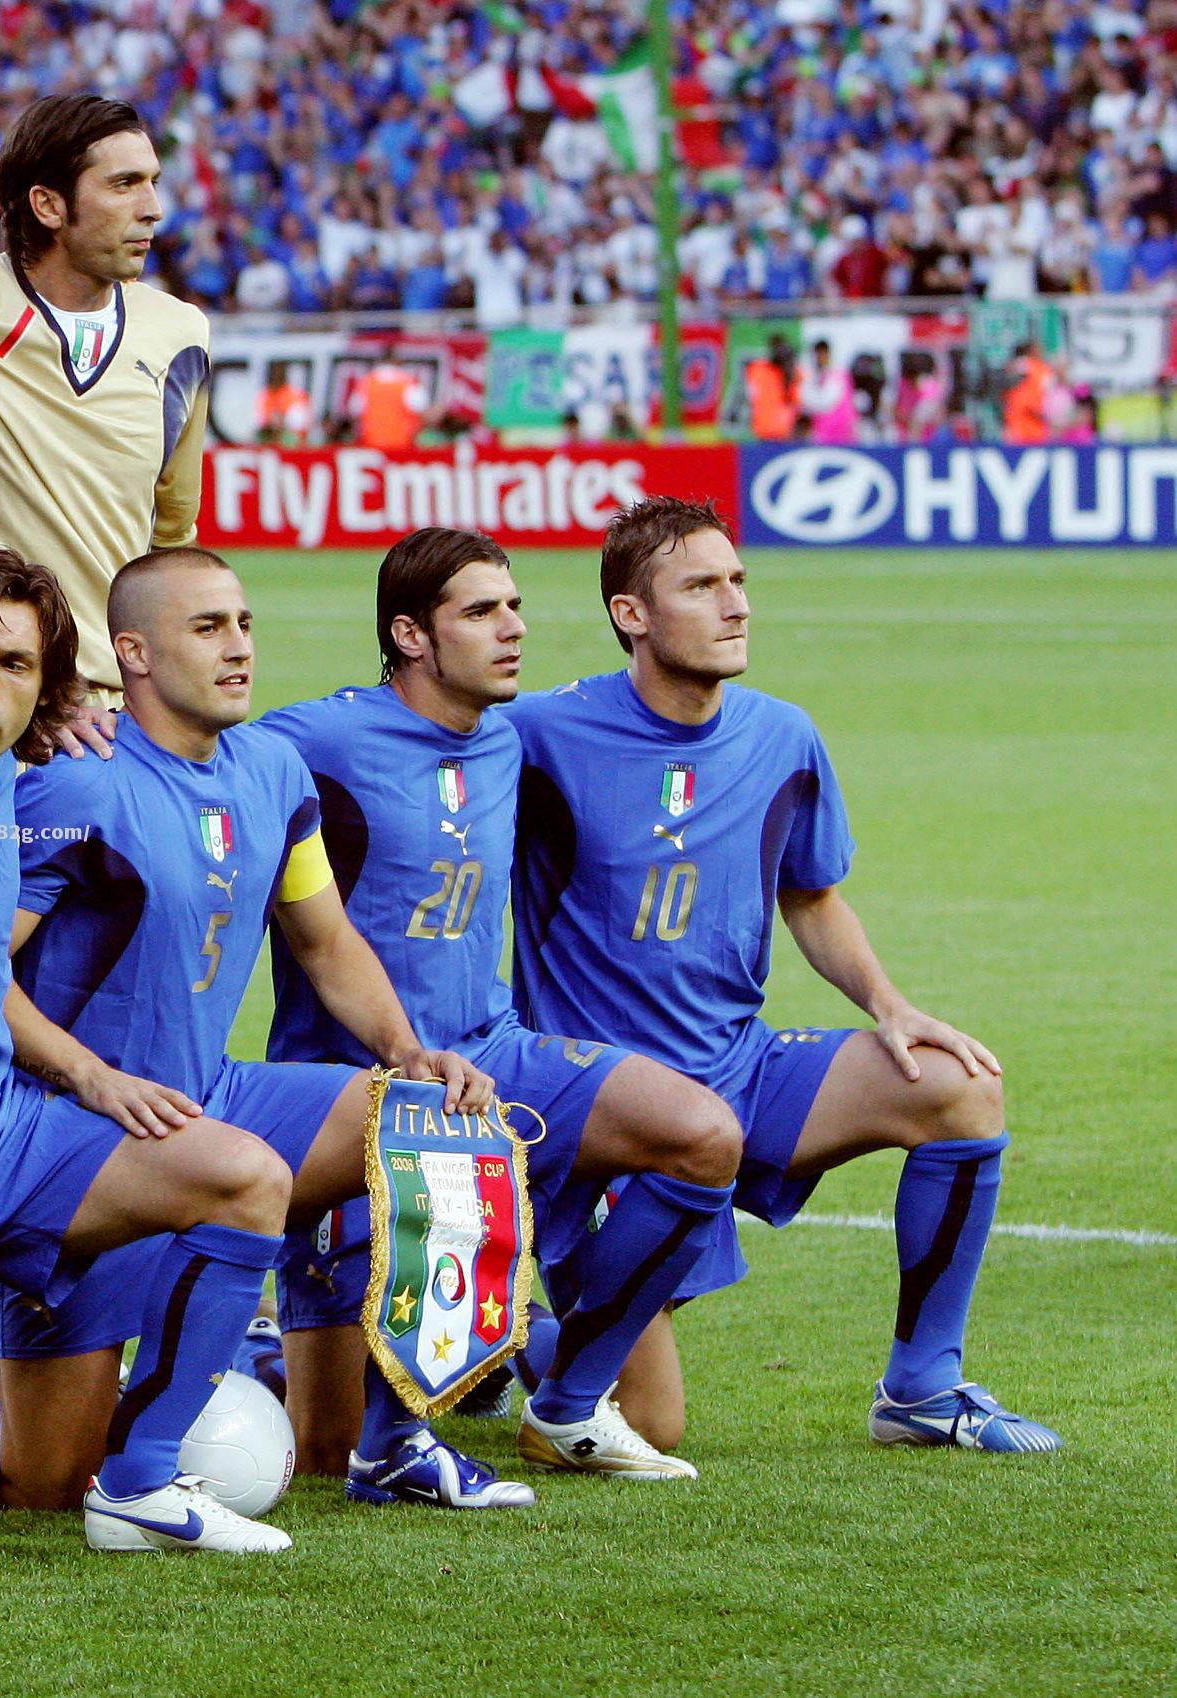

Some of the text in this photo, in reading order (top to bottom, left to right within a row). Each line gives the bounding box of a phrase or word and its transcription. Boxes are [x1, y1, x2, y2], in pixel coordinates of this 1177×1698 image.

[212, 436, 647, 548] Fly Emirates
[440, 760, 462, 769] ITALIA
[200, 807, 227, 815] ITALIA
[405, 859, 484, 940] 20
[631, 860, 699, 941] 10
[192, 911, 232, 993] 5
[394, 1103, 493, 1139] ITALIA
[391, 1156, 505, 1177] 2006 FIFA WORLD CUP
[415, 1193, 451, 1214] ITALY
[466, 1199, 495, 1217] USA
